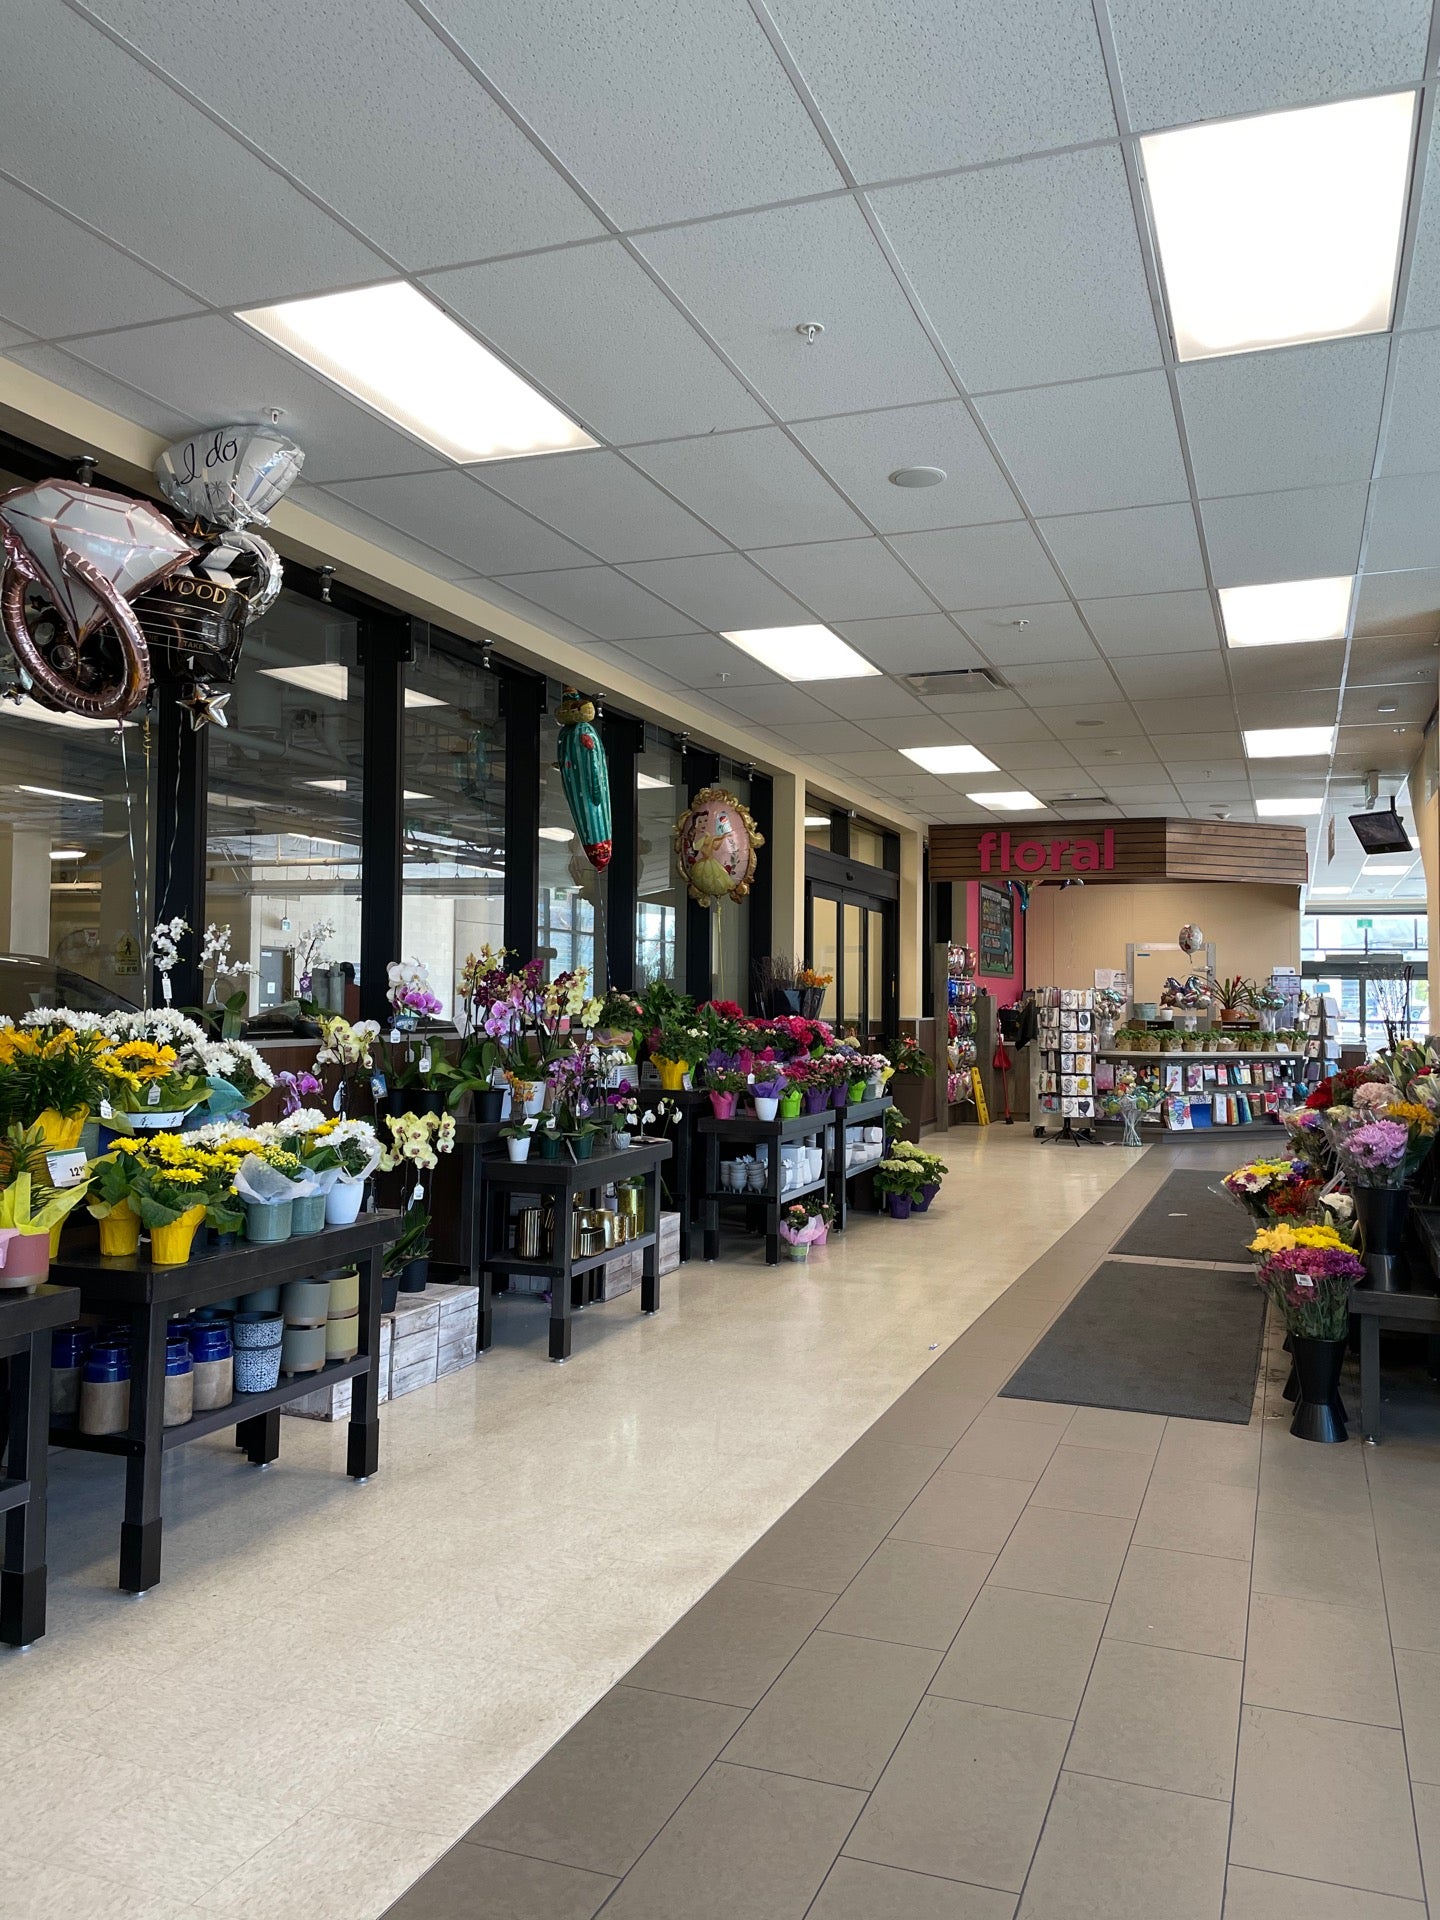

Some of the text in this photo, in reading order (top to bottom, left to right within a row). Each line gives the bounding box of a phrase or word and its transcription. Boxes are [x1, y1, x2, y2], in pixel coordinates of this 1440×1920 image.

[180, 431, 238, 484] I do
[977, 827, 1115, 873] floral
